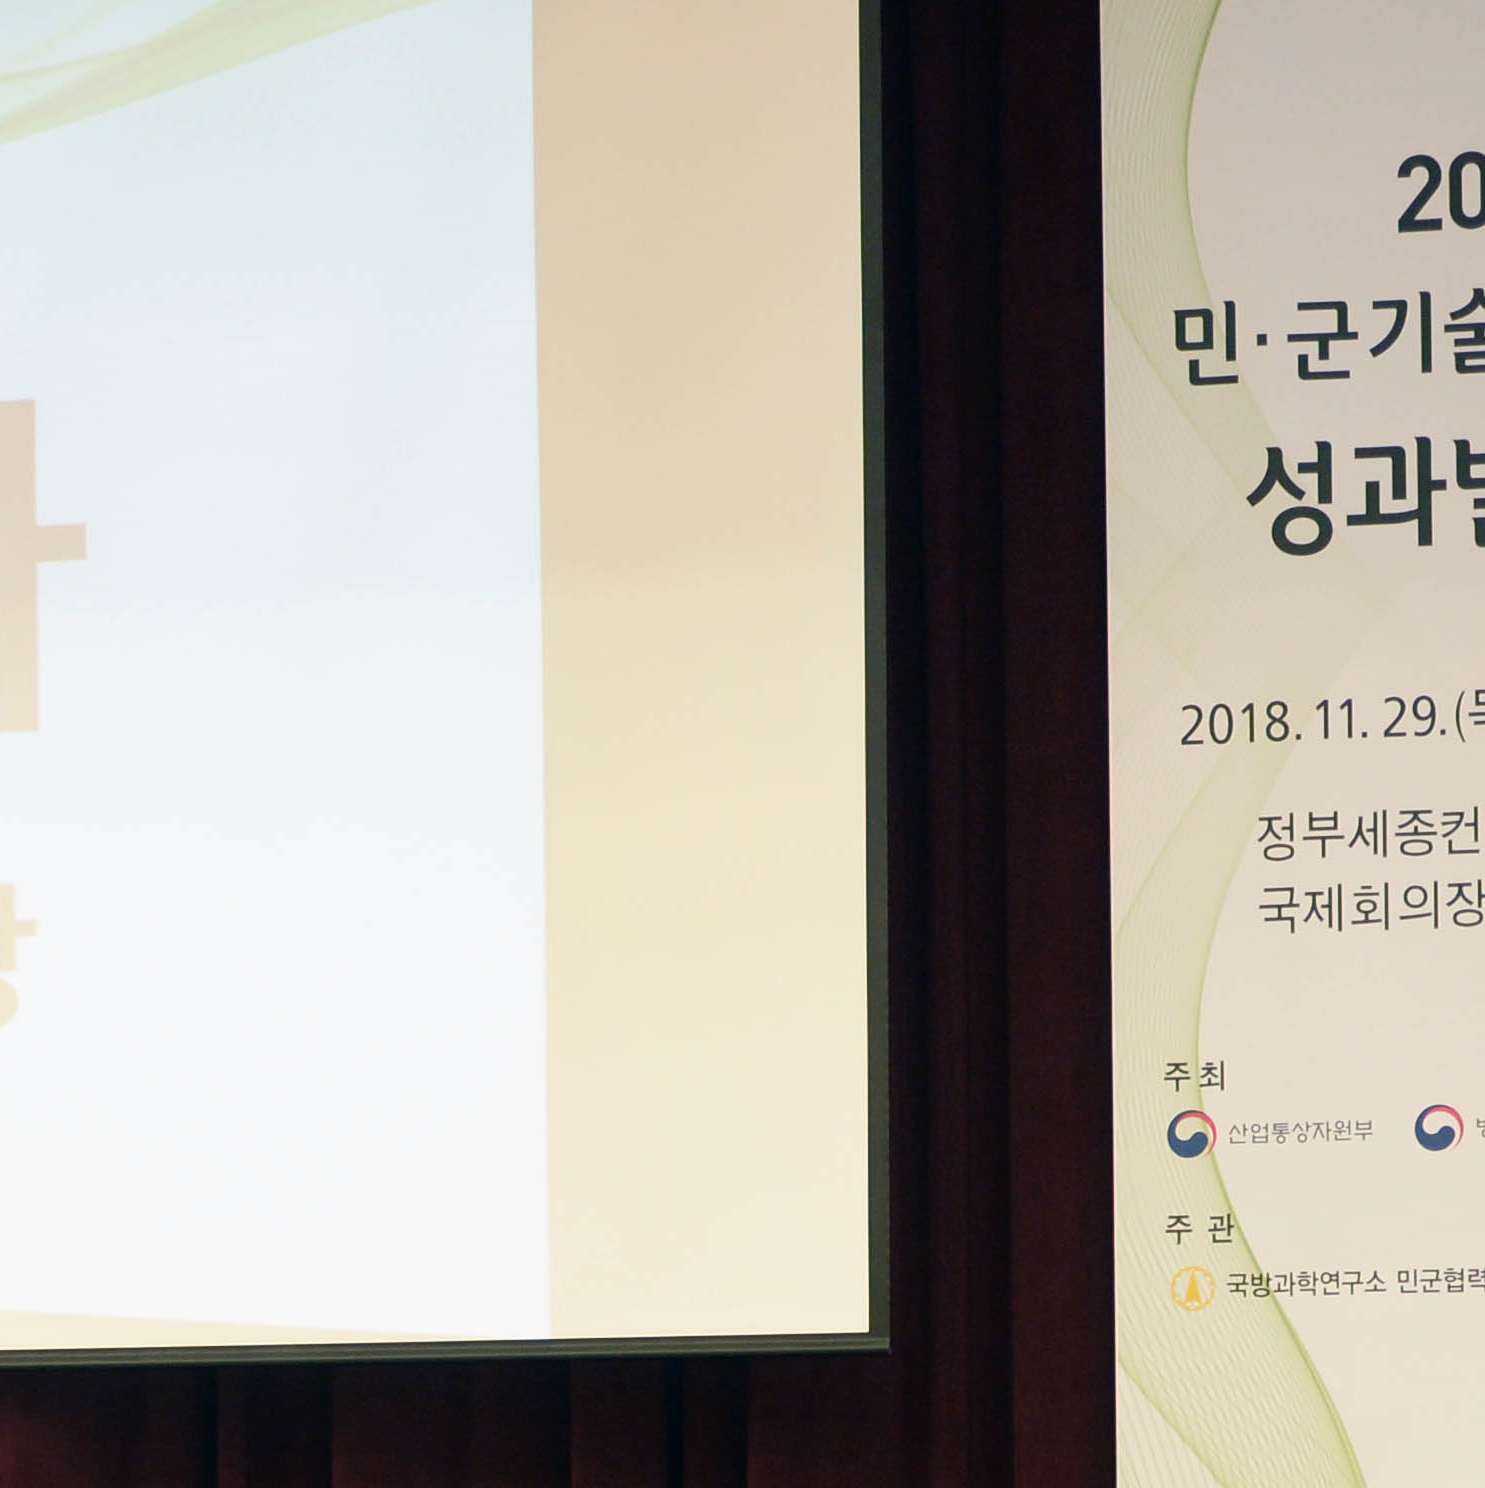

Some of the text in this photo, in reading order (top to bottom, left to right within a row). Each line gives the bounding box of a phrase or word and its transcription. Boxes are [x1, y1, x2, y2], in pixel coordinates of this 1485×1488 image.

[1180, 699, 1302, 746] 2018.
[1315, 697, 1369, 740] 11.
[1256, 805, 1481, 862] 정부세종컨
[1258, 878, 1485, 935] 국제회의장
[1228, 1119, 1374, 1145] 산업통상자원부
[1226, 1270, 1388, 1299] 국방과학연구소
